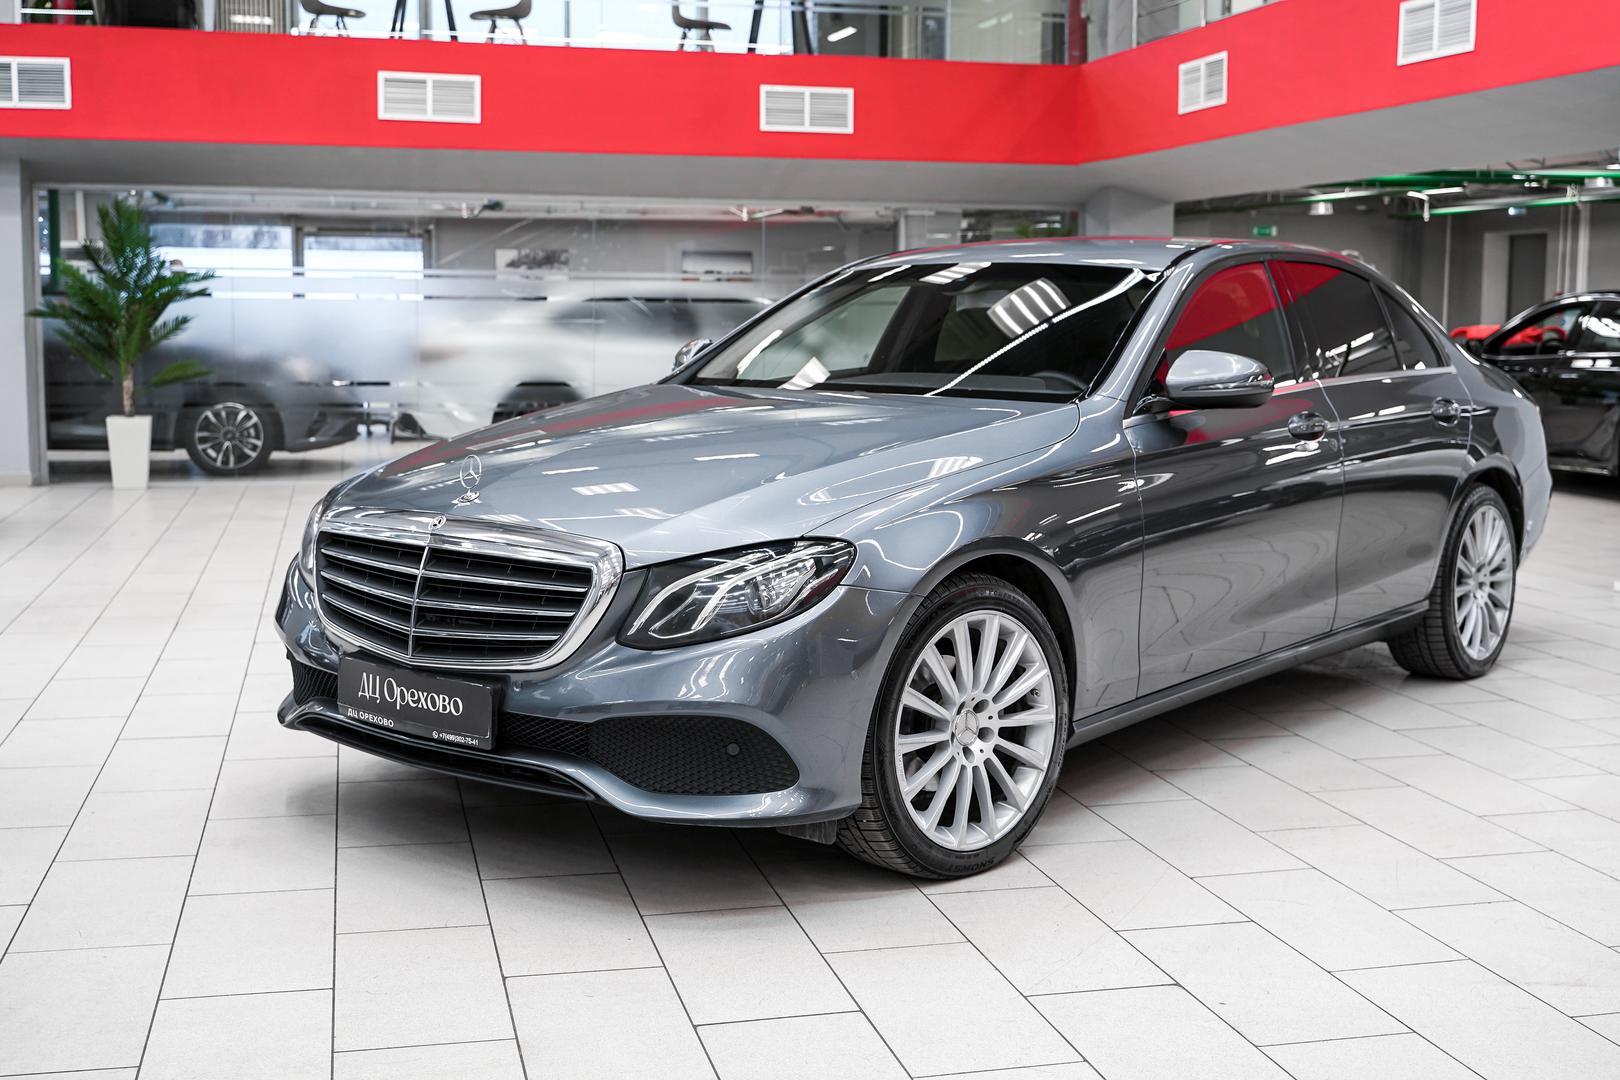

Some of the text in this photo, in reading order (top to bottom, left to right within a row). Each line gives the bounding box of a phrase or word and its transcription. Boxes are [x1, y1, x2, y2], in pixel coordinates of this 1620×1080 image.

[358, 671, 464, 716] ДЦ Орехово
[347, 708, 395, 728] ДЦ ОРЕХОВО
